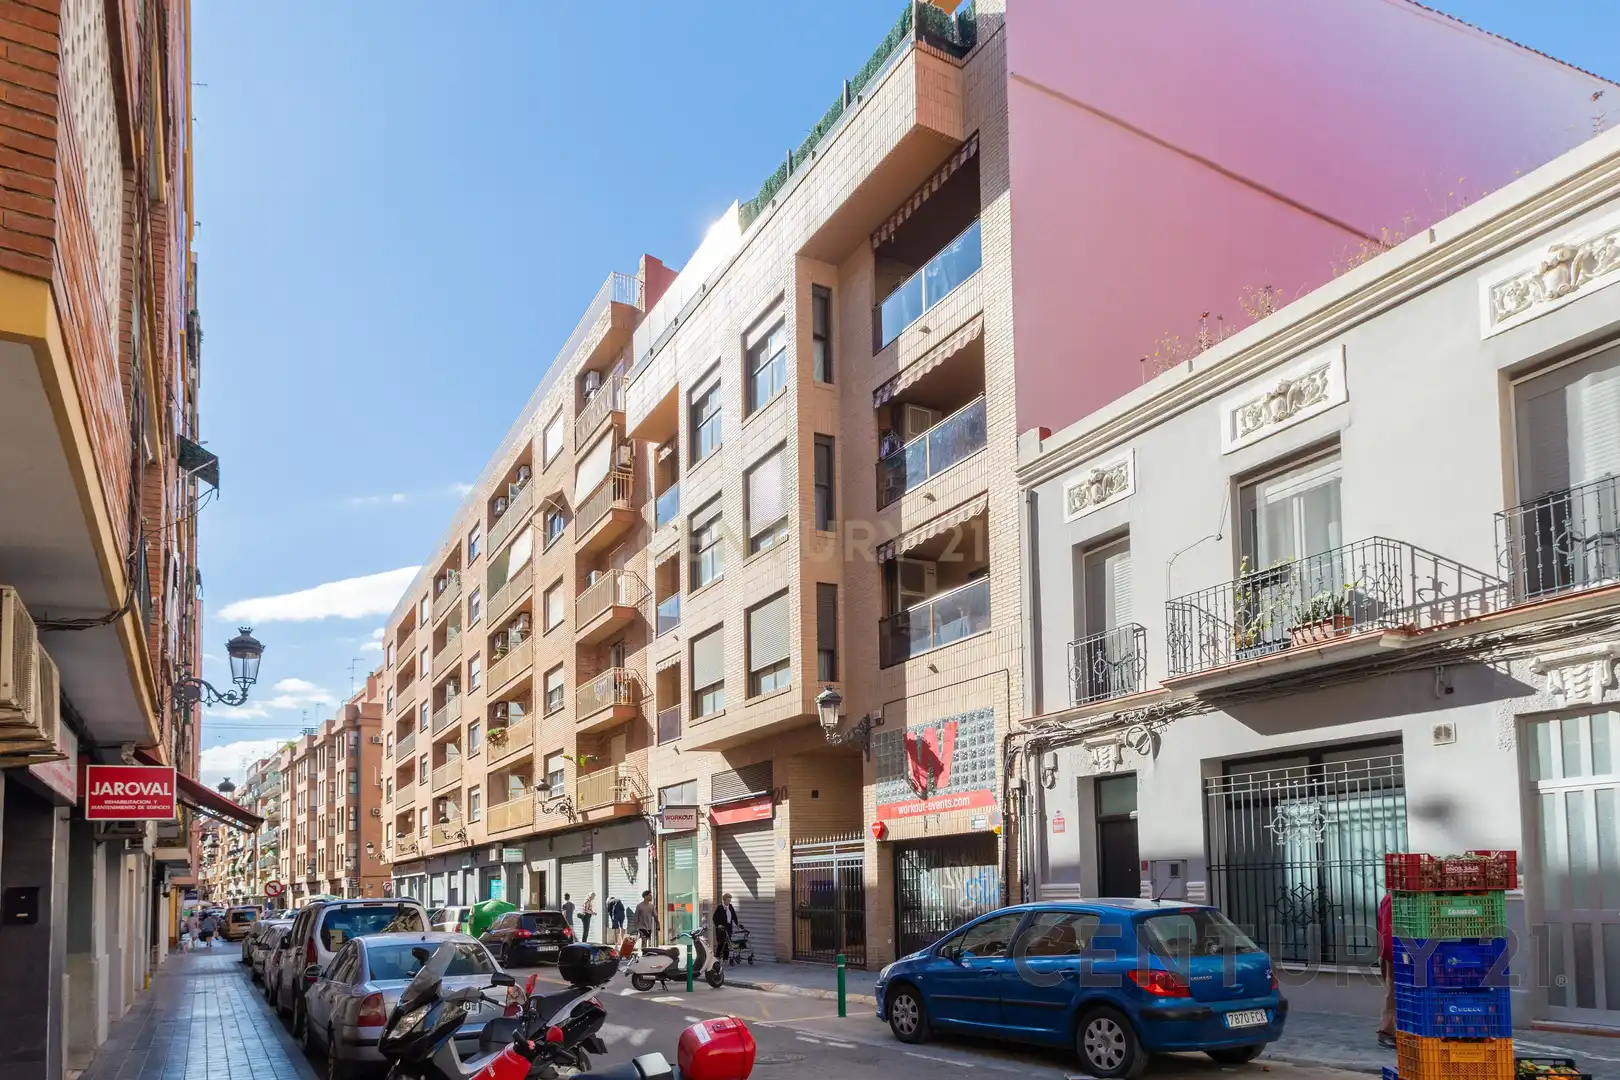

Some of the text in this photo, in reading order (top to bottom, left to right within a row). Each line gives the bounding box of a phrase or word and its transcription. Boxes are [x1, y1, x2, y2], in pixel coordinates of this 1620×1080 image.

[90, 781, 172, 796] JAROVAL
[897, 796, 970, 814] workout-events.com
[1228, 1011, 1266, 1025] 7870 FCX
